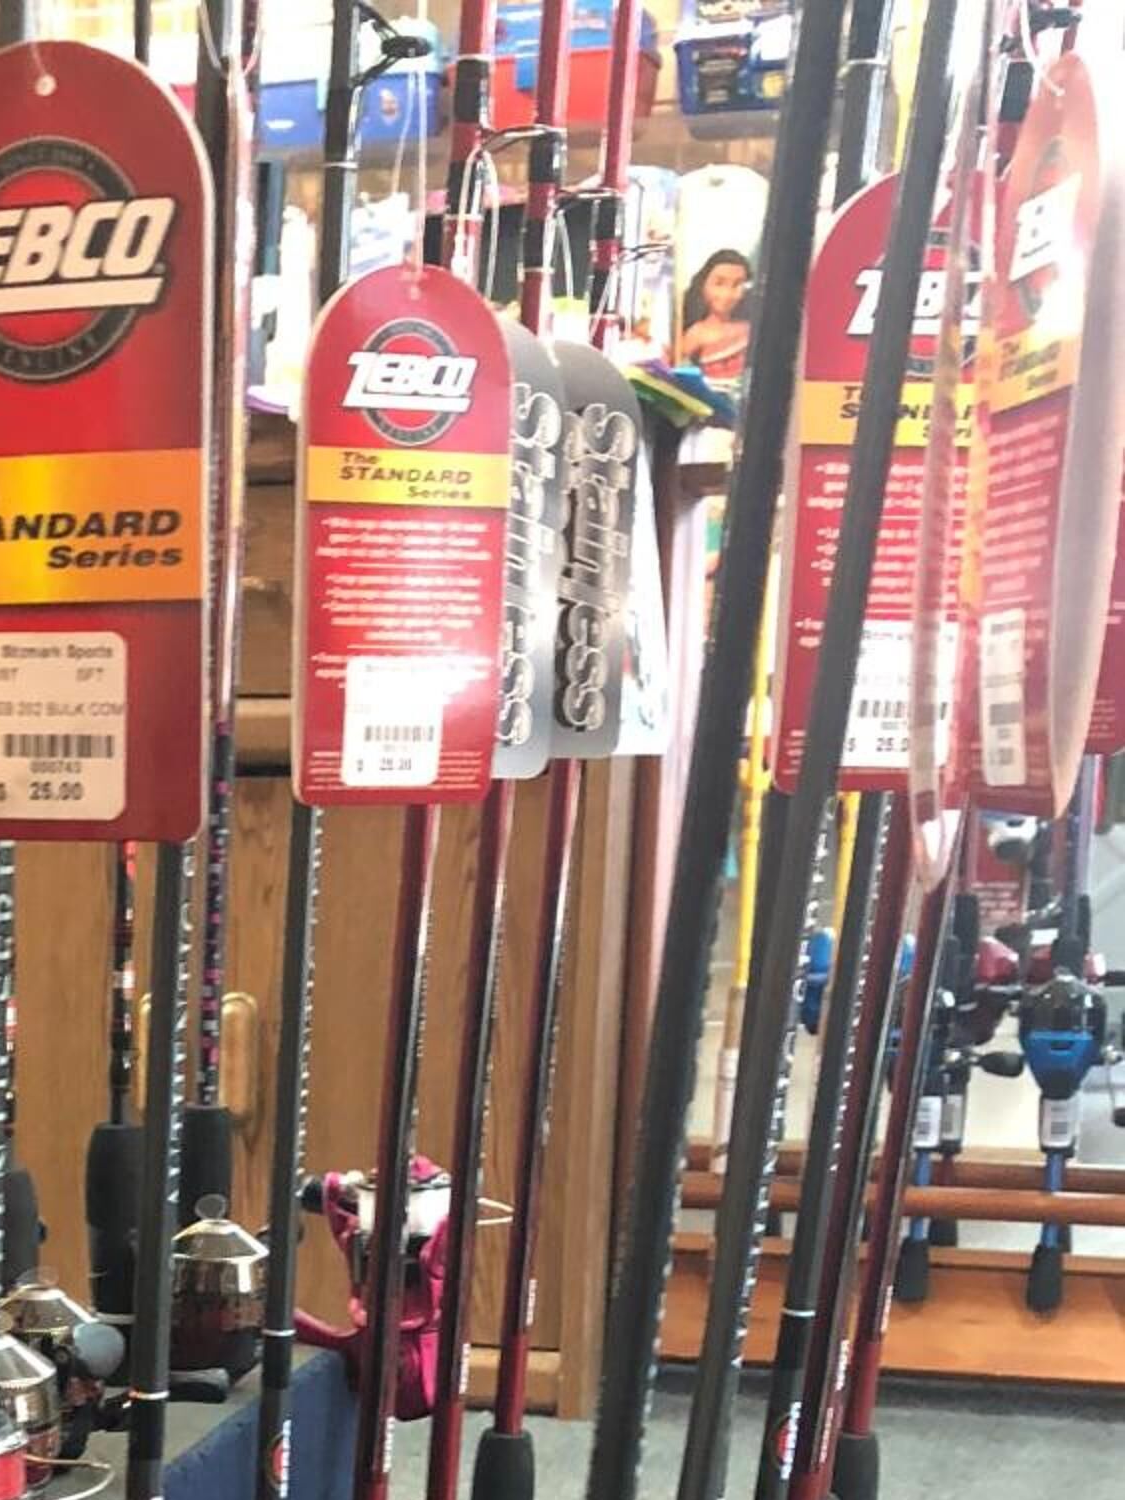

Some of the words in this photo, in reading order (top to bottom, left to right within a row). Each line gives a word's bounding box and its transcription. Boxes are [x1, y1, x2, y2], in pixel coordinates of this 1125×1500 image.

[342, 351, 479, 413] ZEBCO
[342, 451, 380, 465] The
[339, 465, 473, 485] STANDARD
[406, 485, 473, 500] Series
[46, 543, 184, 570] Series
[28, 781, 84, 801] 25.00
